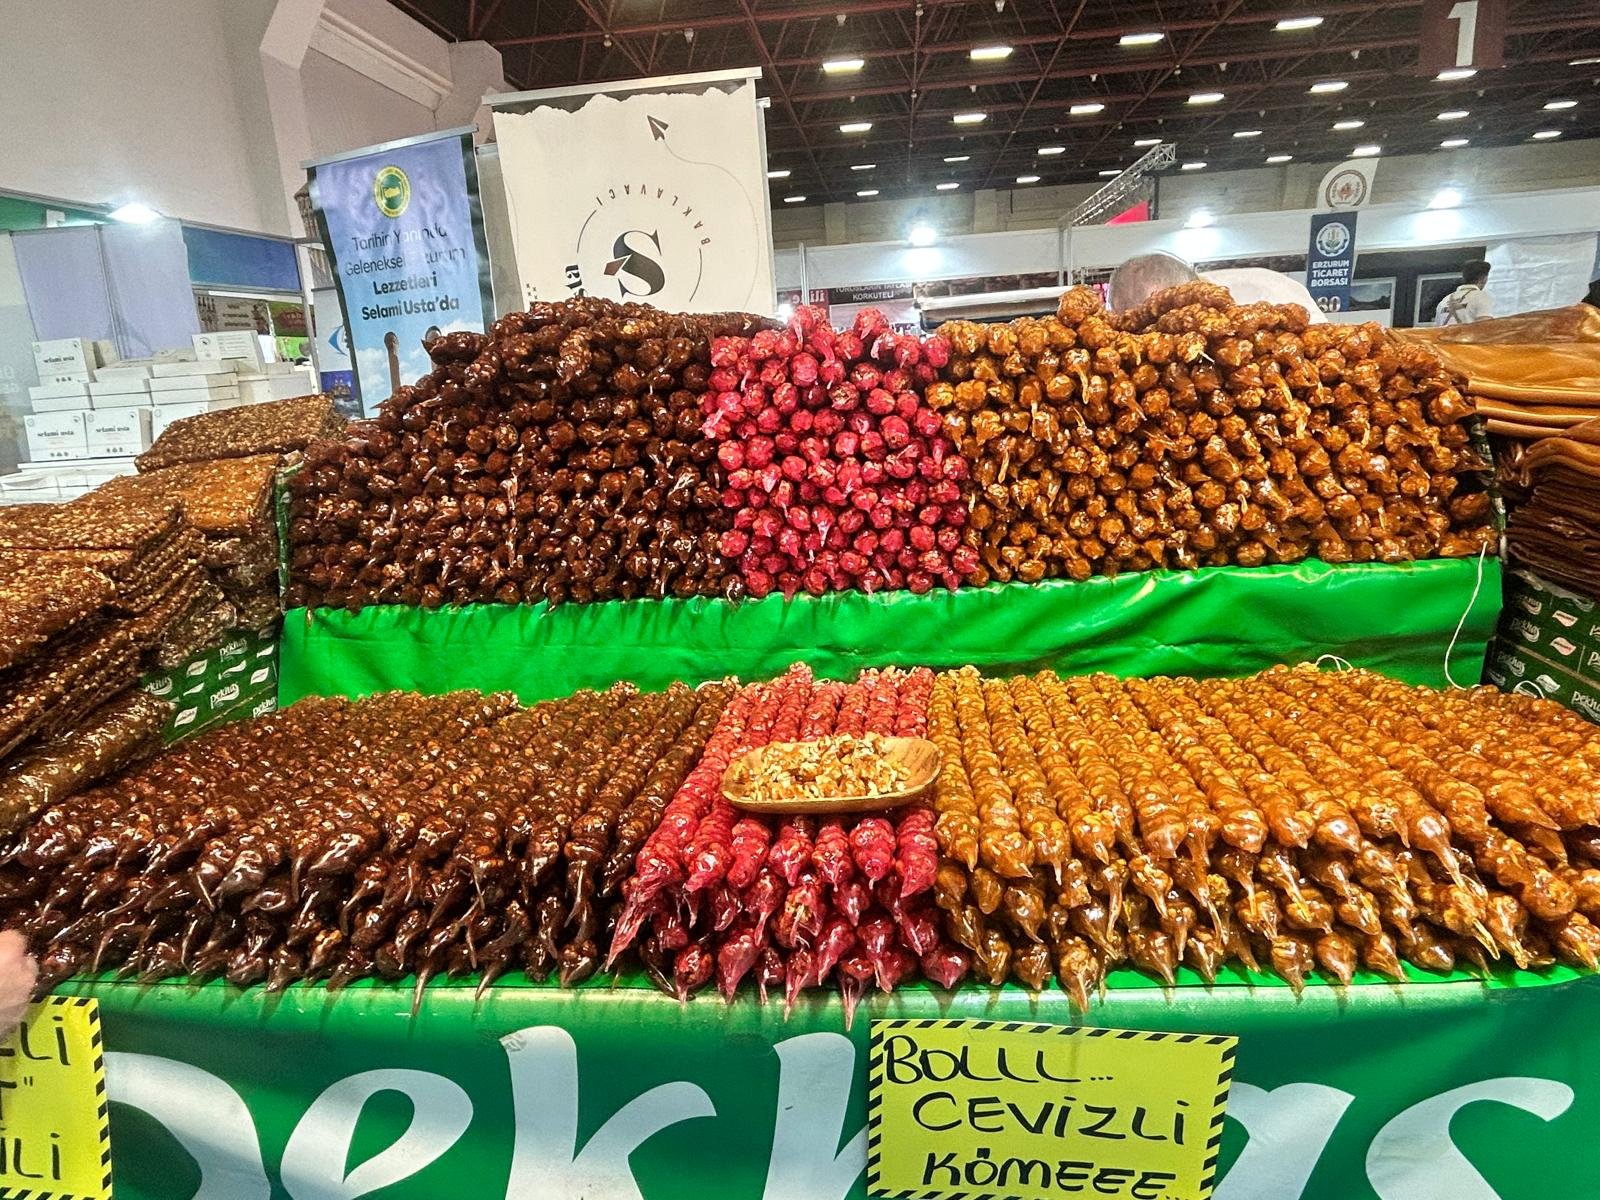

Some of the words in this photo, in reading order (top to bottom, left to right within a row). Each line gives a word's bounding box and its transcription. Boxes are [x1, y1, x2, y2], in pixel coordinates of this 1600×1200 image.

[1448, 1, 1479, 67] 1
[1312, 260, 1350, 269] ERZURUM
[373, 270, 437, 295] Lezzetleri
[1311, 278, 1349, 287] BORSASI
[912, 1091, 1190, 1146] CEVİZLİ
